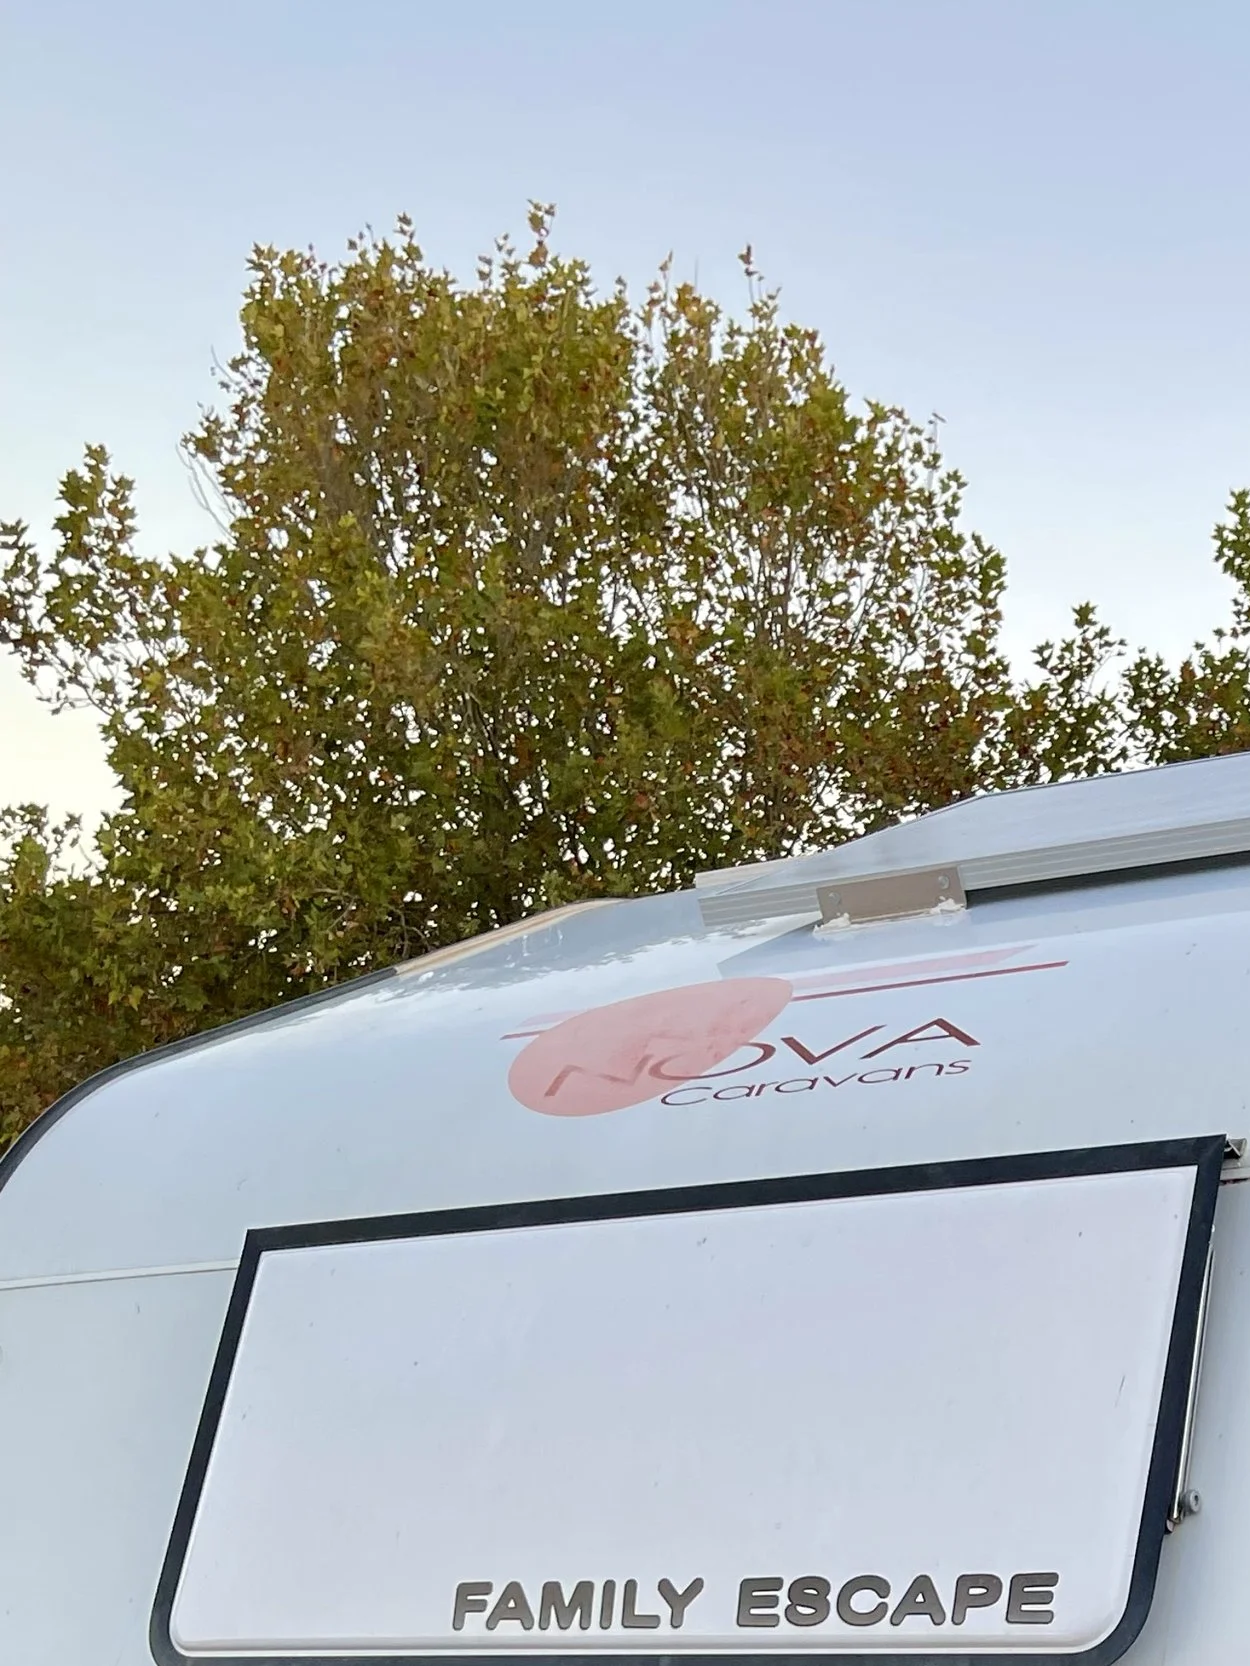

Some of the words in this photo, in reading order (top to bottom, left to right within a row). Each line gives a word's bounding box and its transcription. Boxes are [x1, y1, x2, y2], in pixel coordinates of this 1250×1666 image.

[543, 1017, 982, 1099] NOVA
[451, 1576, 704, 1631] FAMILY
[736, 1571, 1060, 1629] ESCAPE
